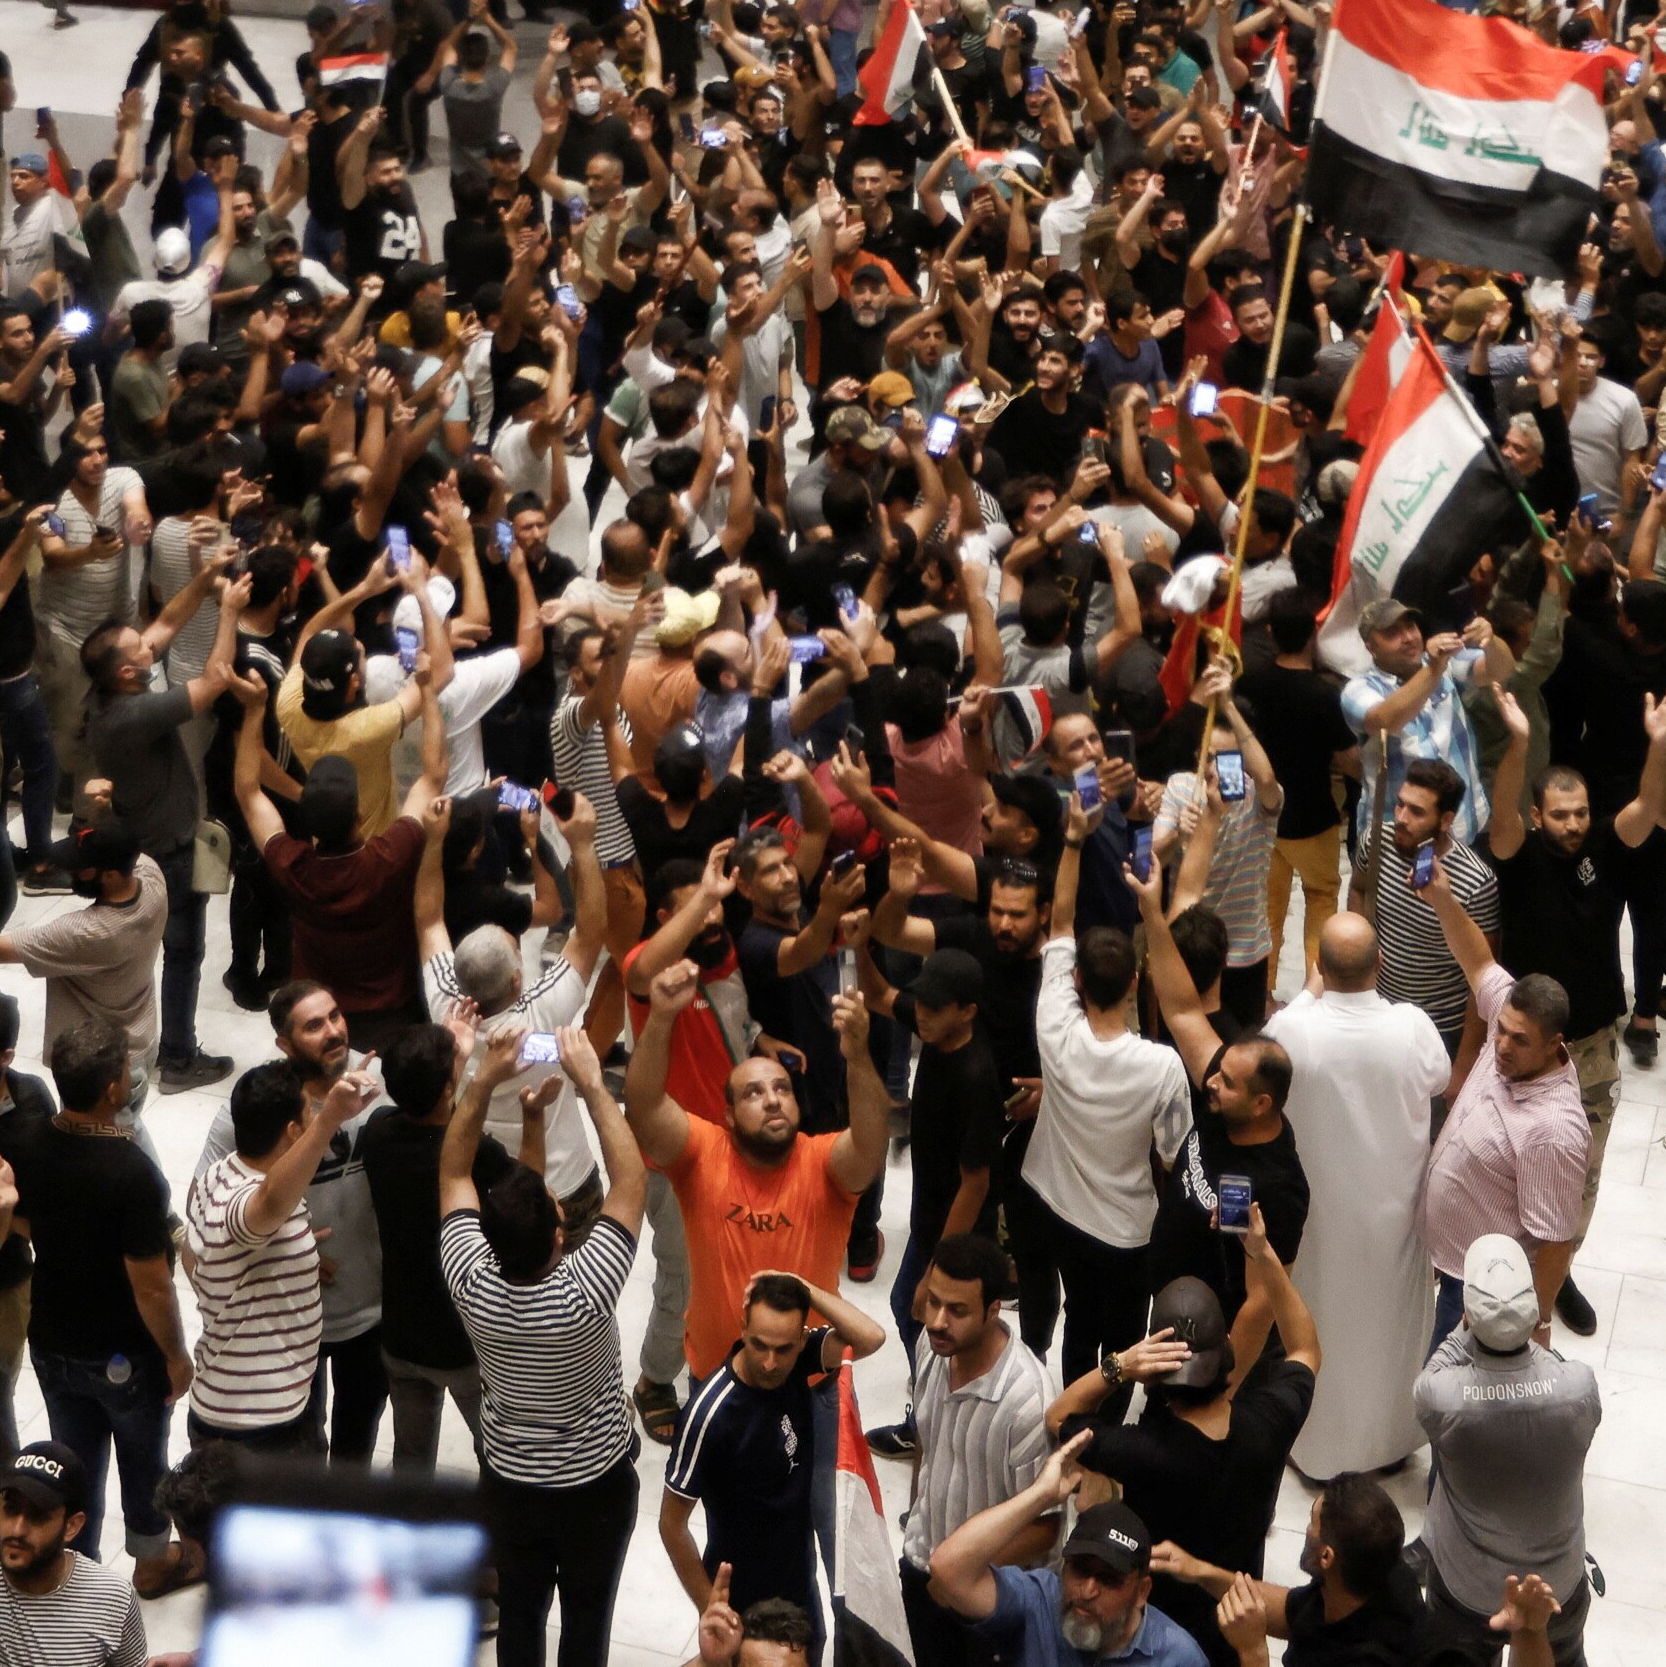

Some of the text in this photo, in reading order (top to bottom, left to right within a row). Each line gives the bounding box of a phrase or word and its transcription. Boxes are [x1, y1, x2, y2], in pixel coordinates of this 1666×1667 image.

[379, 210, 421, 261] 24
[725, 1202, 794, 1234] ZARA
[1463, 1379, 1554, 1402] POLOONSNOW
[14, 1454, 64, 1479] GUCCI
